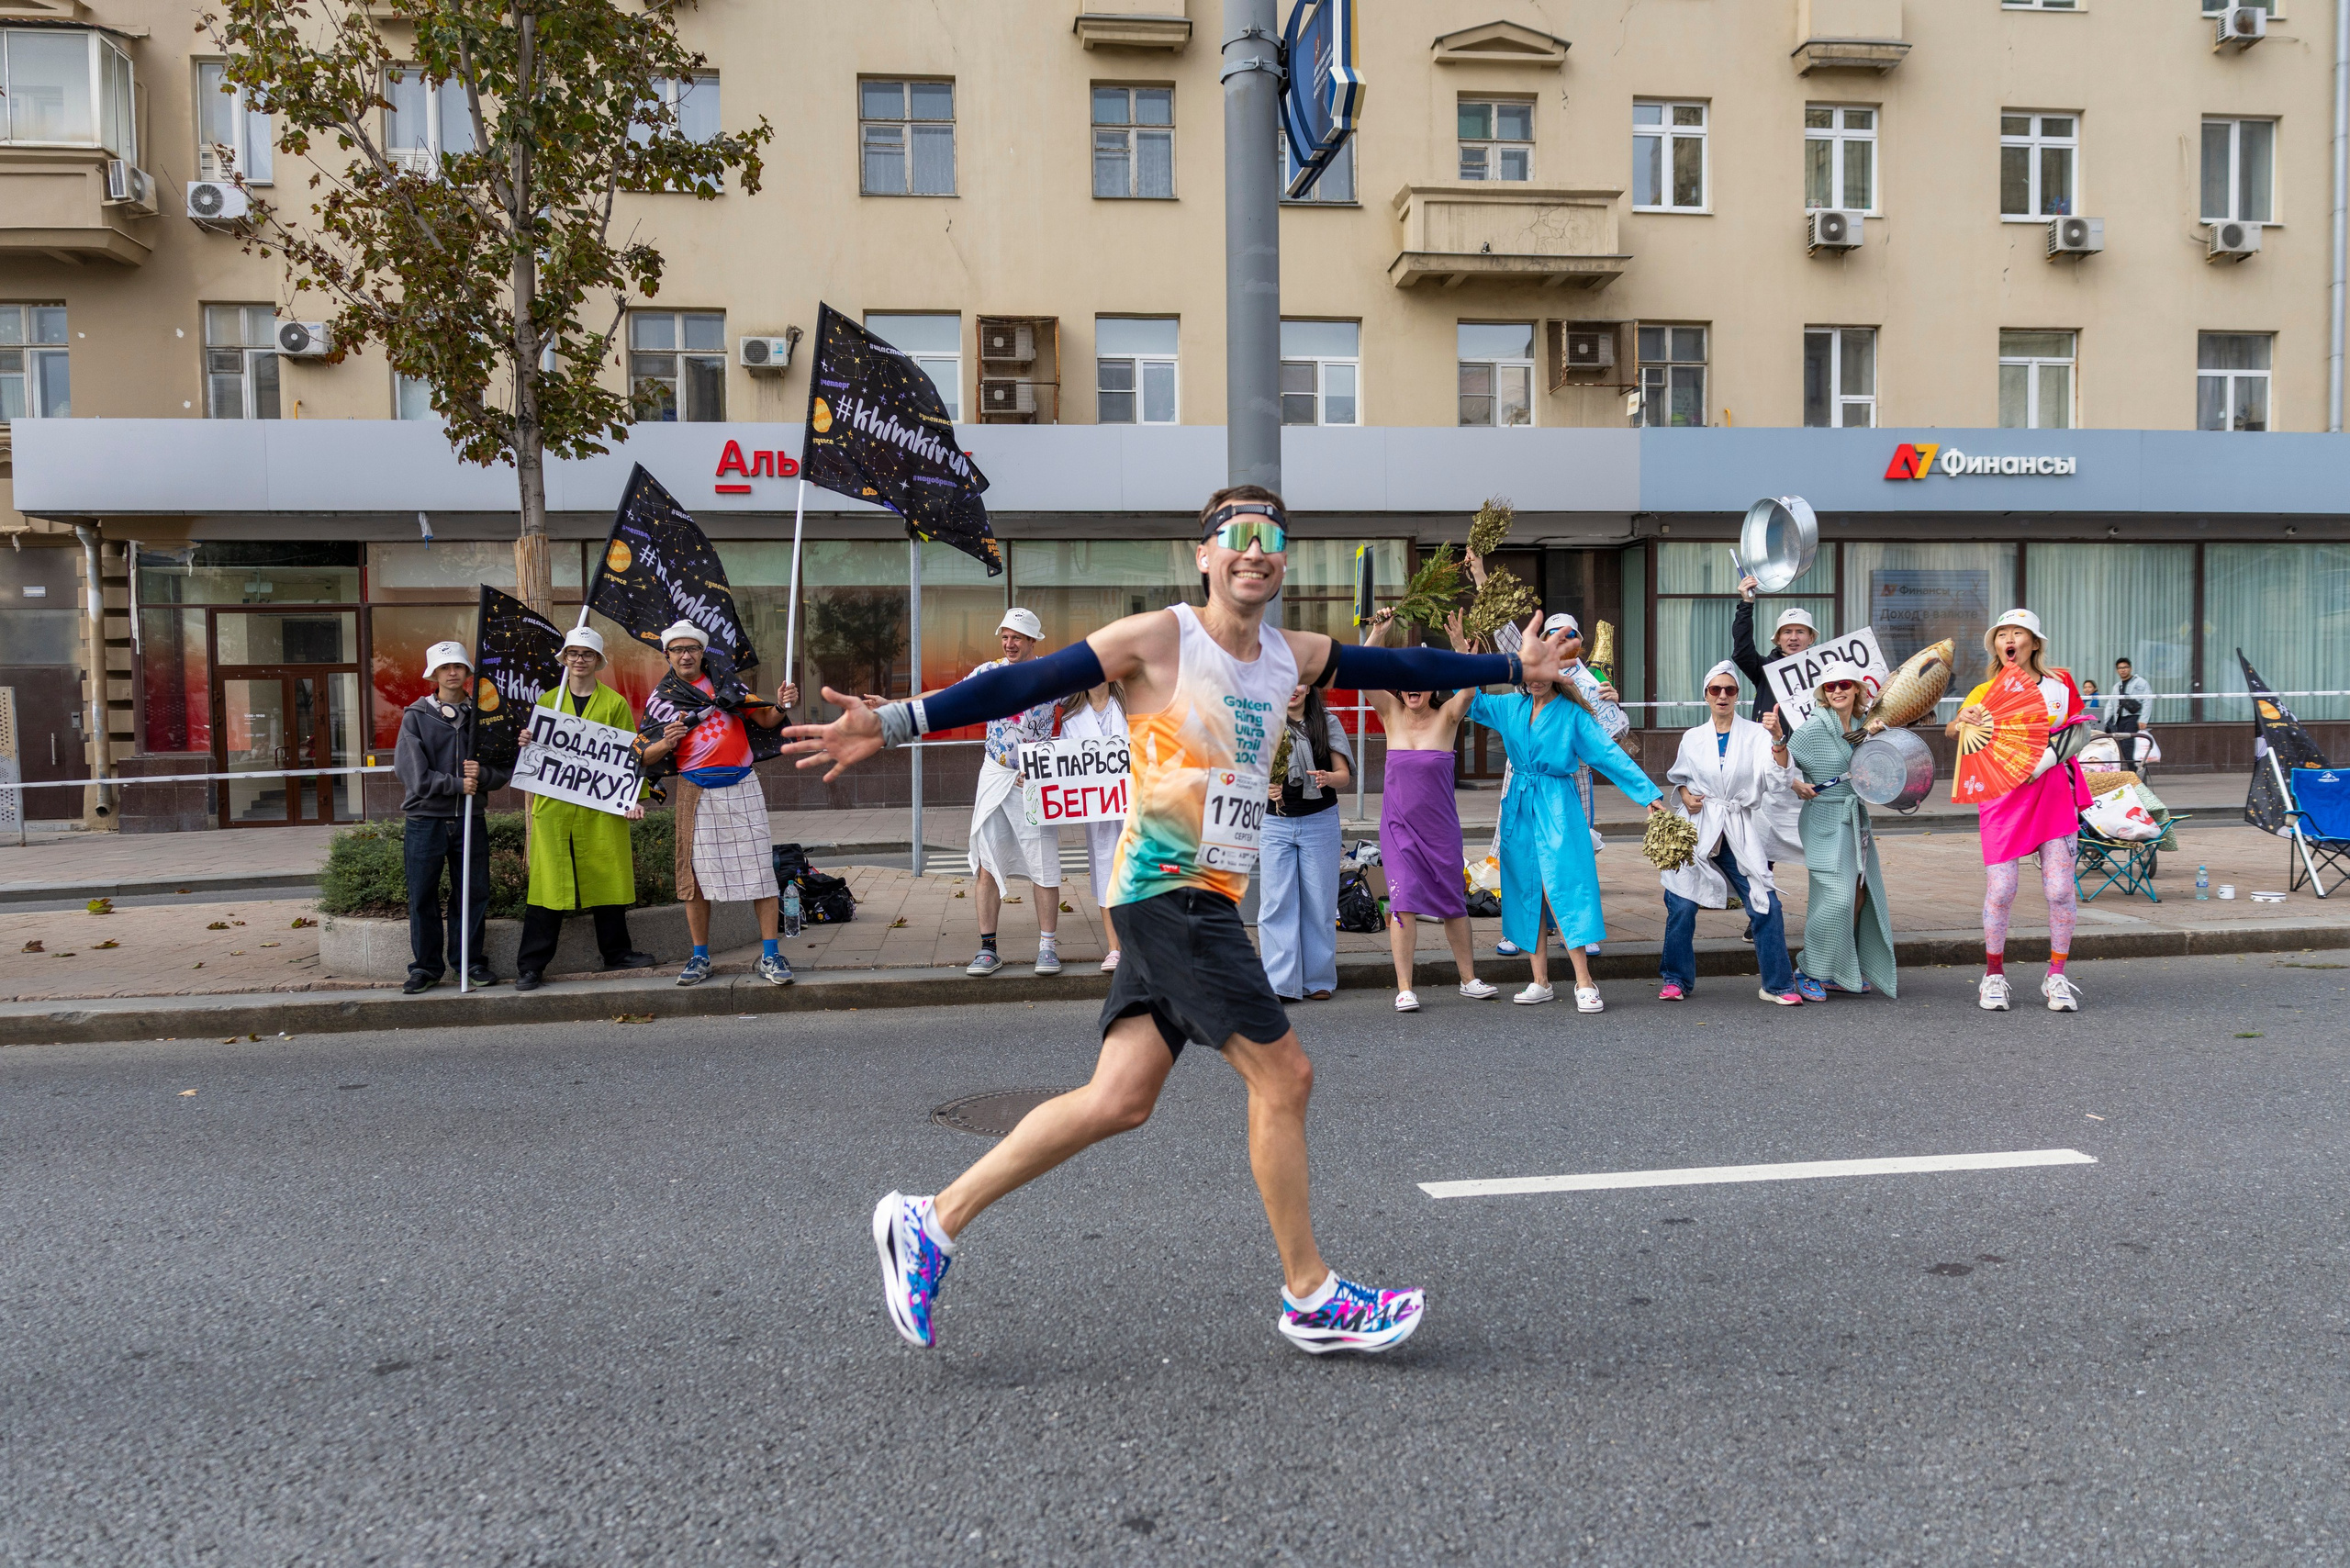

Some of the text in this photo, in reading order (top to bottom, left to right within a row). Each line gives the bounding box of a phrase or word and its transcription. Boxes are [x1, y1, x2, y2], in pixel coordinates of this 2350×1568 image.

[1941, 448, 2076, 477] Финансы
[1898, 585, 1950, 596] Финансы
[1880, 608, 1920, 622] Доход
[1933, 610, 1978, 620] валюте
[1224, 695, 1272, 711] Golden
[1235, 710, 1263, 727] Ring
[1235, 722, 1265, 738] Ultra
[1236, 737, 1261, 751] Trail
[1023, 749, 1131, 779] НЕ ПАРЬСЯ
[1235, 752, 1257, 765] 100
[1041, 778, 1128, 820] БЕГИ!
[1235, 832, 1253, 842] СЕРГЕЙ
